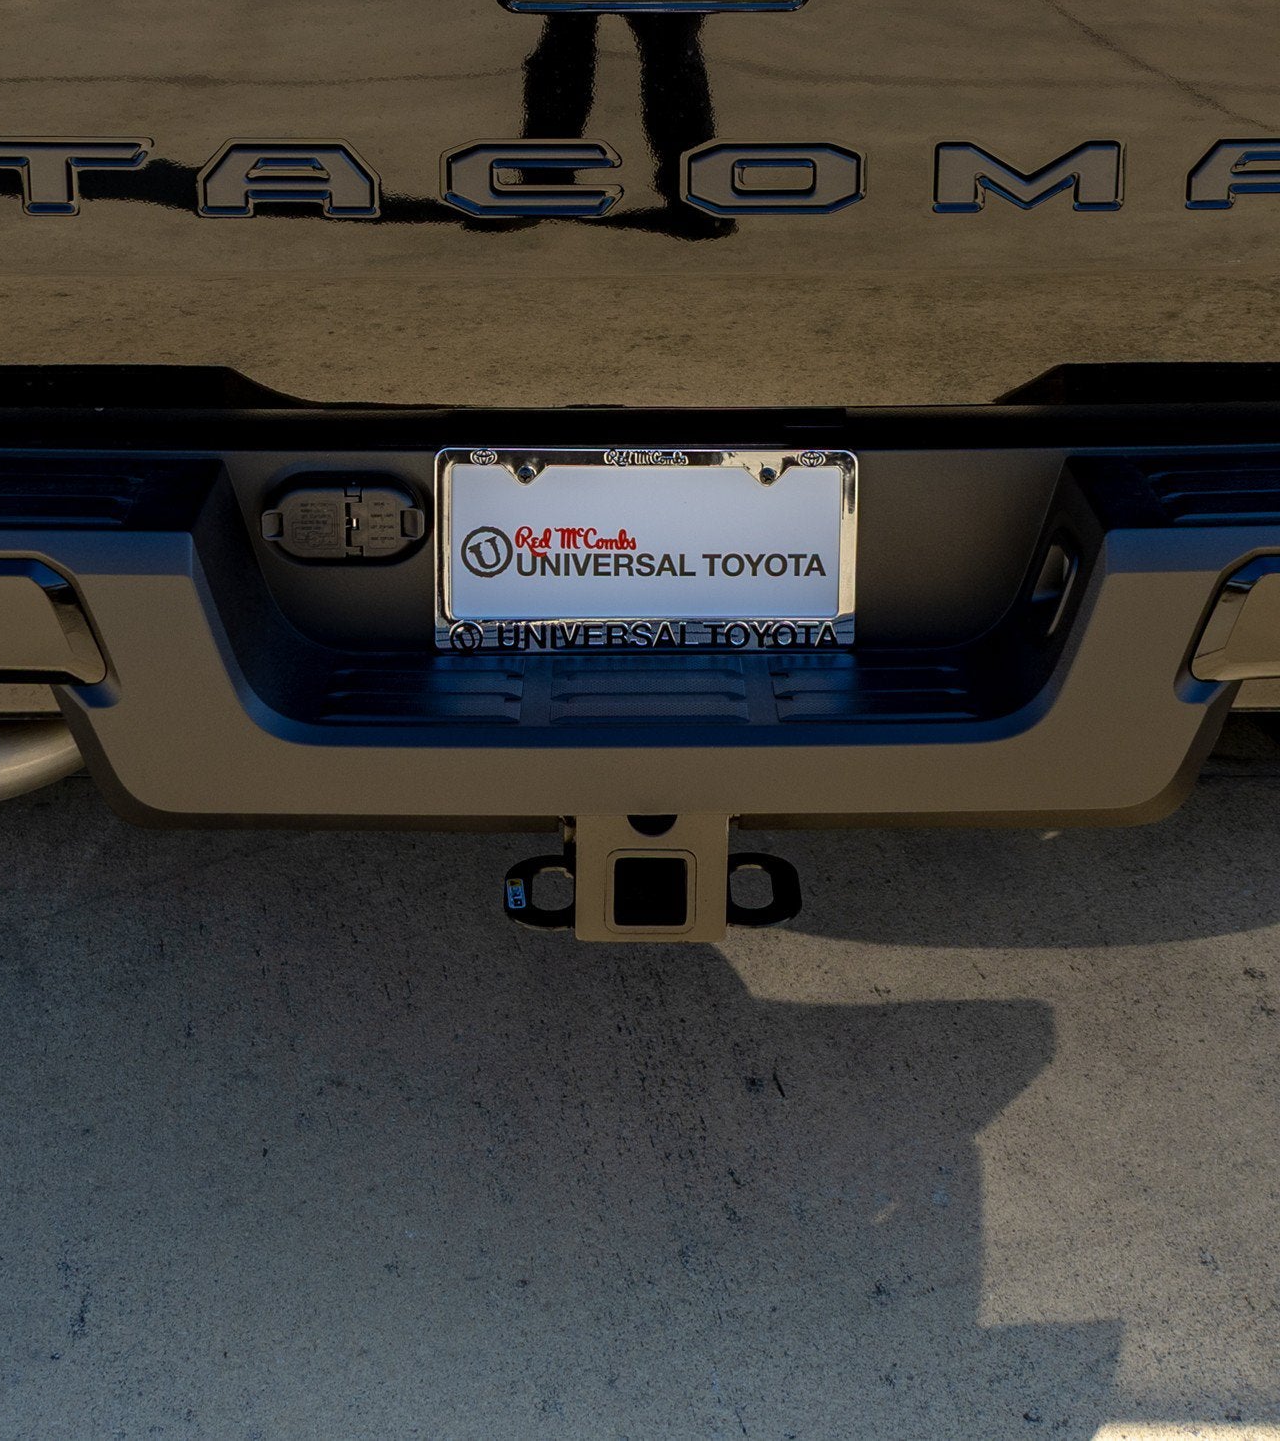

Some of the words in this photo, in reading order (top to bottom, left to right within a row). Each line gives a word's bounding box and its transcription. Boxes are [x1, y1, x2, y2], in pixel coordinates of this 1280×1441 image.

[514, 525, 552, 558] Red
[554, 527, 638, 551] McCombs
[516, 552, 697, 577] UNIVERSAL
[702, 553, 827, 577] TOYOTA
[497, 620, 699, 651] UNIVERSAL
[703, 620, 840, 650] TOYOTA
